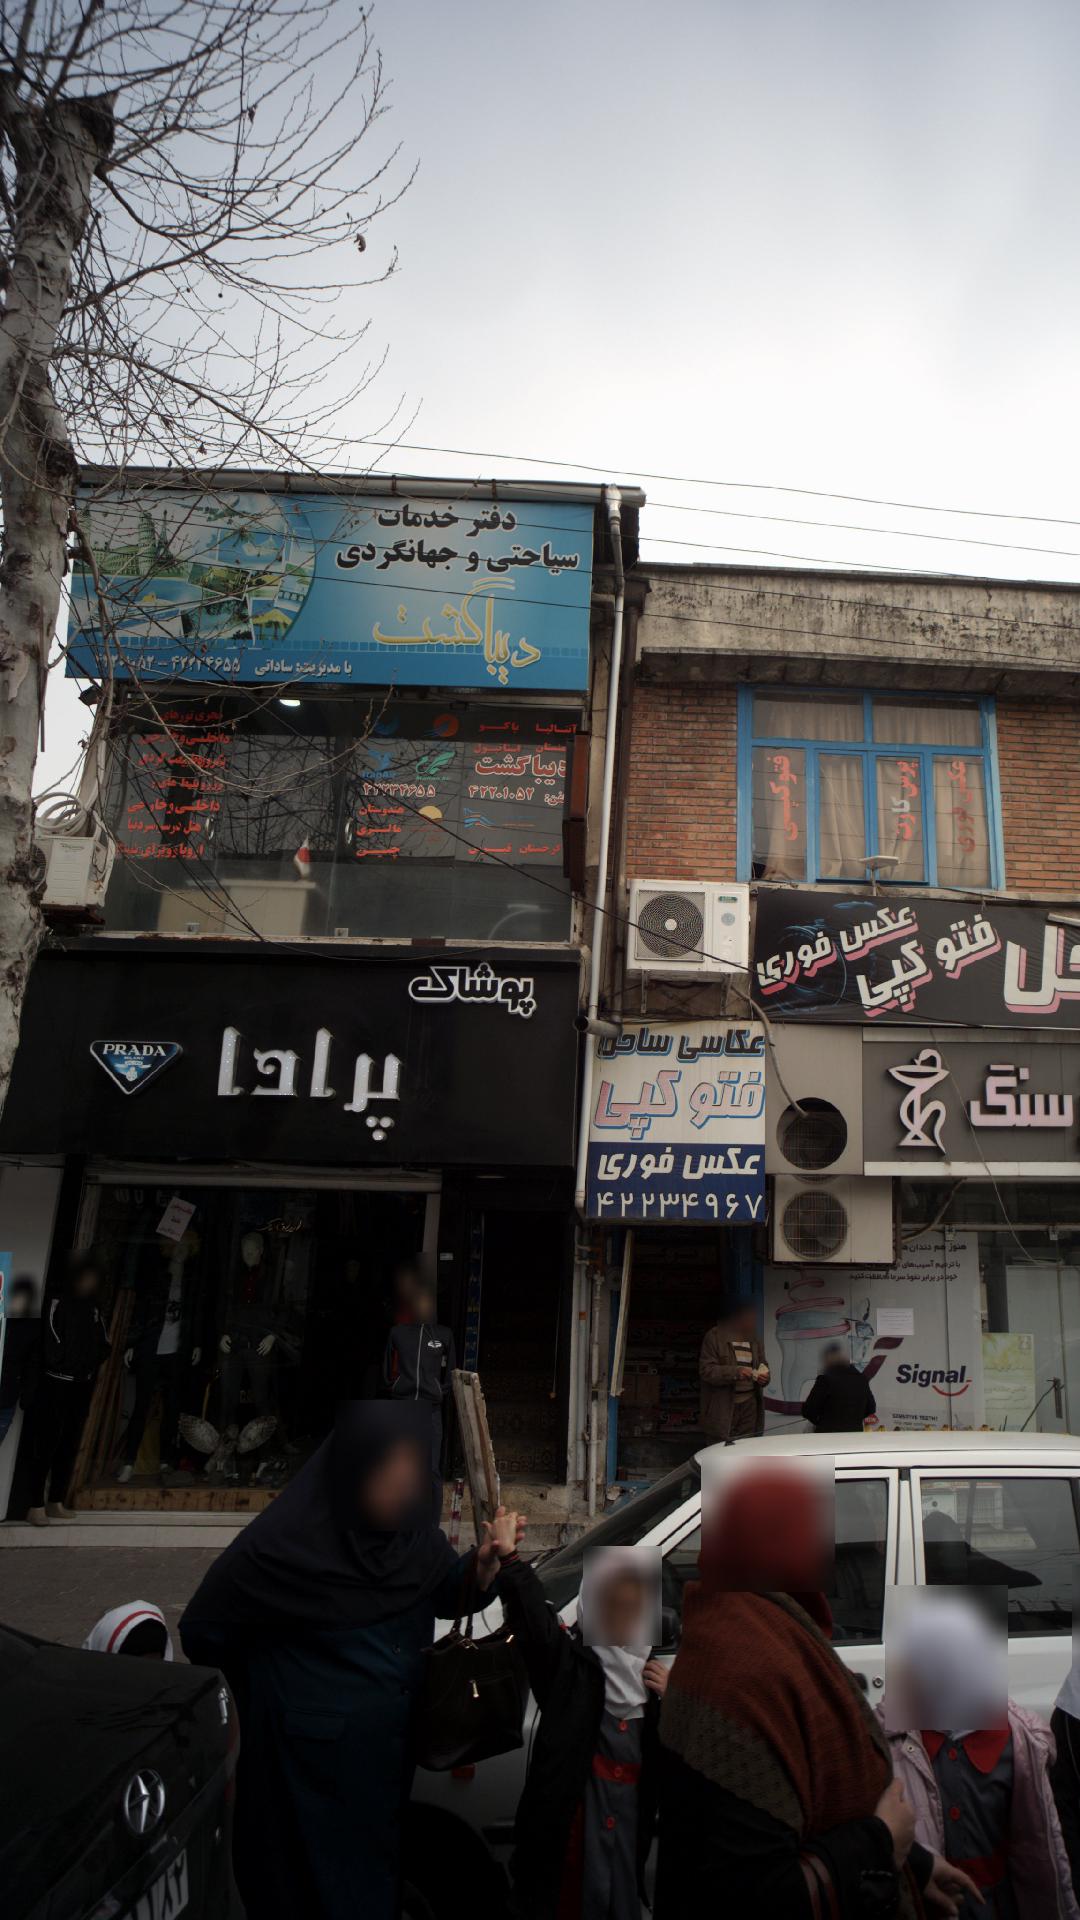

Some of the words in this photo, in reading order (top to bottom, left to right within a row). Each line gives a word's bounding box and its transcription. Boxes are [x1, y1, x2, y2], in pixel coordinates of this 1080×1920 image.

[378, 503, 459, 528] خدمات
[466, 504, 516, 536] دفتر
[337, 539, 457, 570] جهانگردی
[465, 551, 479, 571] و
[487, 542, 578, 574] سیاحتی
[255, 658, 293, 676] ساداتی
[344, 660, 352, 676] با
[475, 753, 567, 785] دیباگشت
[175, 799, 220, 815] داخلی
[467, 785, 535, 800] ۴۲۲۰۱۰۵۲
[840, 906, 919, 960] عکس
[756, 931, 838, 995] فوری
[408, 961, 537, 1018] پوشاک
[102, 1043, 167, 1056] PRADA
[677, 1029, 765, 1062] عکاسی
[217, 1025, 406, 1141] پرادا
[969, 1063, 1074, 1127] سنگ
[597, 1146, 675, 1181] فوری
[682, 1147, 761, 1180] عکس
[597, 1191, 763, 1219] ۴۲۲۳۴۹۶۷
[896, 1363, 967, 1388] Signal
